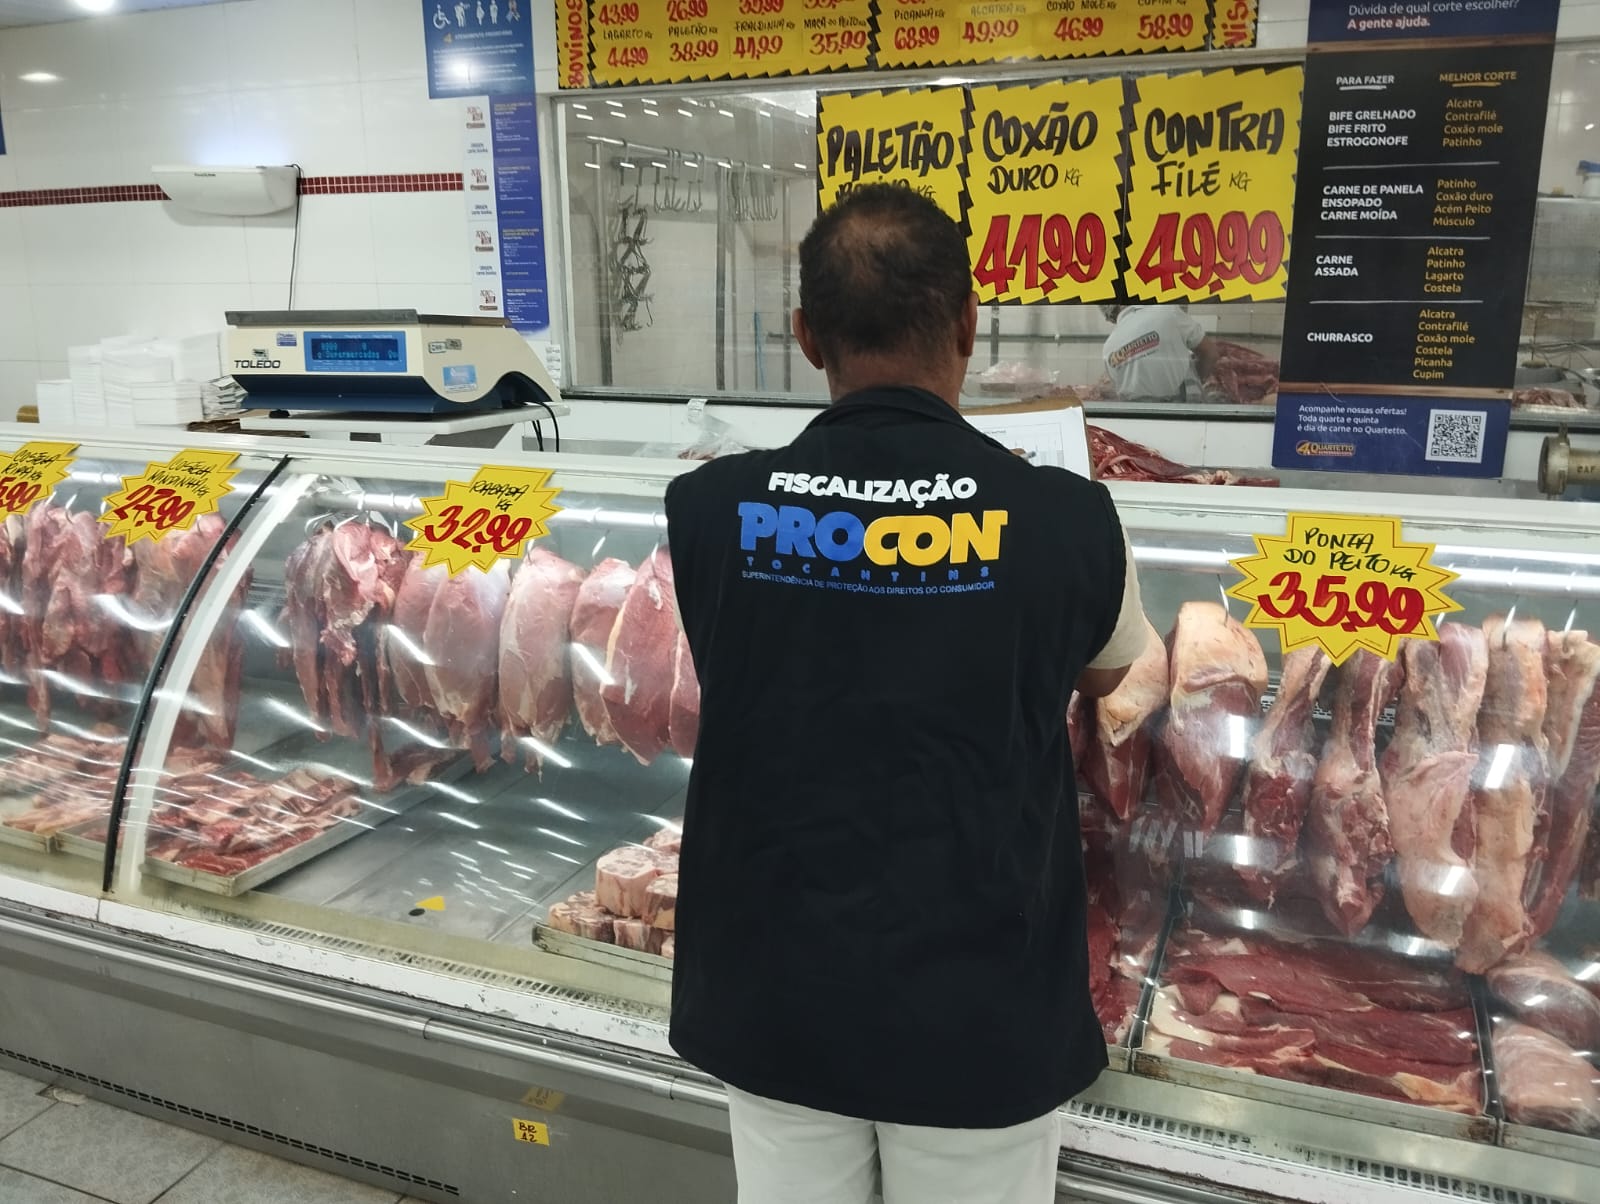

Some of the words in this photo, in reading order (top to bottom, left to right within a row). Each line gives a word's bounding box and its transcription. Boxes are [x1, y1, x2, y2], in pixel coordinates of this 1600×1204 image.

[1348, 4, 1387, 16] Dúvida
[1390, 3, 1404, 14] de
[1406, 1, 1431, 15] qual
[1433, 1, 1463, 12] corte
[1465, 0, 1519, 11] escolher?
[734, 19, 784, 32] FRALDINHA
[1347, 19, 1357, 30] A
[1359, 18, 1393, 31] gente
[1395, 16, 1431, 30] ajuda.
[603, 29, 643, 40] LAGARTO
[1336, 76, 1362, 86] PARA
[1363, 74, 1395, 84] FAZER
[1439, 72, 1481, 82] MELHOR
[1483, 71, 1517, 81] CORTE
[1446, 99, 1483, 108] Alcatra
[1329, 111, 1353, 121] BIFE
[1355, 109, 1416, 120] GRELHADO
[1445, 112, 1497, 121] Contrafilé
[983, 101, 1098, 162] COXÃO
[1144, 101, 1285, 162] CONTRA
[1328, 124, 1352, 134] BIFE
[1354, 123, 1387, 134] FRITO
[1444, 125, 1475, 135] Coxão
[1477, 124, 1504, 134] mole
[1327, 136, 1409, 147] ESTROGONOFE
[1442, 137, 1482, 147] Patinho
[827, 120, 954, 181] PALETÃO
[987, 164, 1059, 194] DURO
[1065, 168, 1083, 187] KG
[1229, 170, 1253, 192] KG
[1437, 179, 1477, 189] Patinho
[1323, 186, 1360, 195] CARNE
[1362, 185, 1378, 194] DE
[1379, 184, 1424, 195] PANELA
[1436, 191, 1467, 201] Coxão
[1469, 191, 1494, 201] duro
[1321, 197, 1382, 208] ENSOPADO
[1320, 210, 1358, 220] CARNE
[1359, 208, 1397, 220] MOÍDA
[1434, 204, 1463, 214] Acém
[1465, 204, 1492, 214] Peito
[1433, 216, 1475, 227] Músculo
[1428, 246, 1465, 256] Alcatra
[1316, 255, 1353, 265] CARNE
[1426, 259, 1466, 269] Patinho
[1314, 267, 1359, 277] ASSADA
[1425, 271, 1464, 283] Lagarto
[1423, 283, 1462, 293] Costela
[1419, 309, 1456, 319] Alcatra
[1418, 321, 1469, 331] Contrafilé
[1307, 332, 1373, 343] CHURRASCO
[1416, 333, 1448, 343] Coxão
[1450, 333, 1475, 344] mole
[1415, 345, 1453, 355] Costela
[234, 359, 281, 369] TOLEDO
[1414, 357, 1453, 367] Picanha
[1413, 369, 1445, 380] Cupim
[1299, 405, 1345, 416] Acompanhe
[1346, 406, 1373, 414] nossas
[1374, 407, 1407, 415] ofertas!
[1298, 414, 1317, 422] Toda
[1318, 416, 1344, 424] quarta
[1352, 416, 1379, 425] quinta
[1303, 424, 1316, 432] dia
[1317, 424, 1328, 432] de
[1328, 425, 1351, 433] carne
[1364, 425, 1407, 435] Quartetto.
[768, 472, 977, 508] FISCALIZAÇÃO
[495, 499, 513, 512] KG
[738, 502, 1008, 566] PROCON
[1304, 527, 1374, 553] PONTA
[747, 556, 989, 582] TOCANTINS
[1283, 548, 1316, 566] DO
[1329, 551, 1390, 574] PEITO
[1389, 564, 1418, 582] KG
[742, 570, 814, 587] SUPERINTENDÊNCIA
[815, 580, 825, 588] DE
[826, 581, 868, 592] PROTEÇÃO
[869, 586, 885, 594] AOS
[886, 586, 924, 595] DIREITOS
[925, 586, 938, 594] DO
[939, 581, 995, 593] CONSUMIDOR
[518, 1122, 537, 1133] BR
